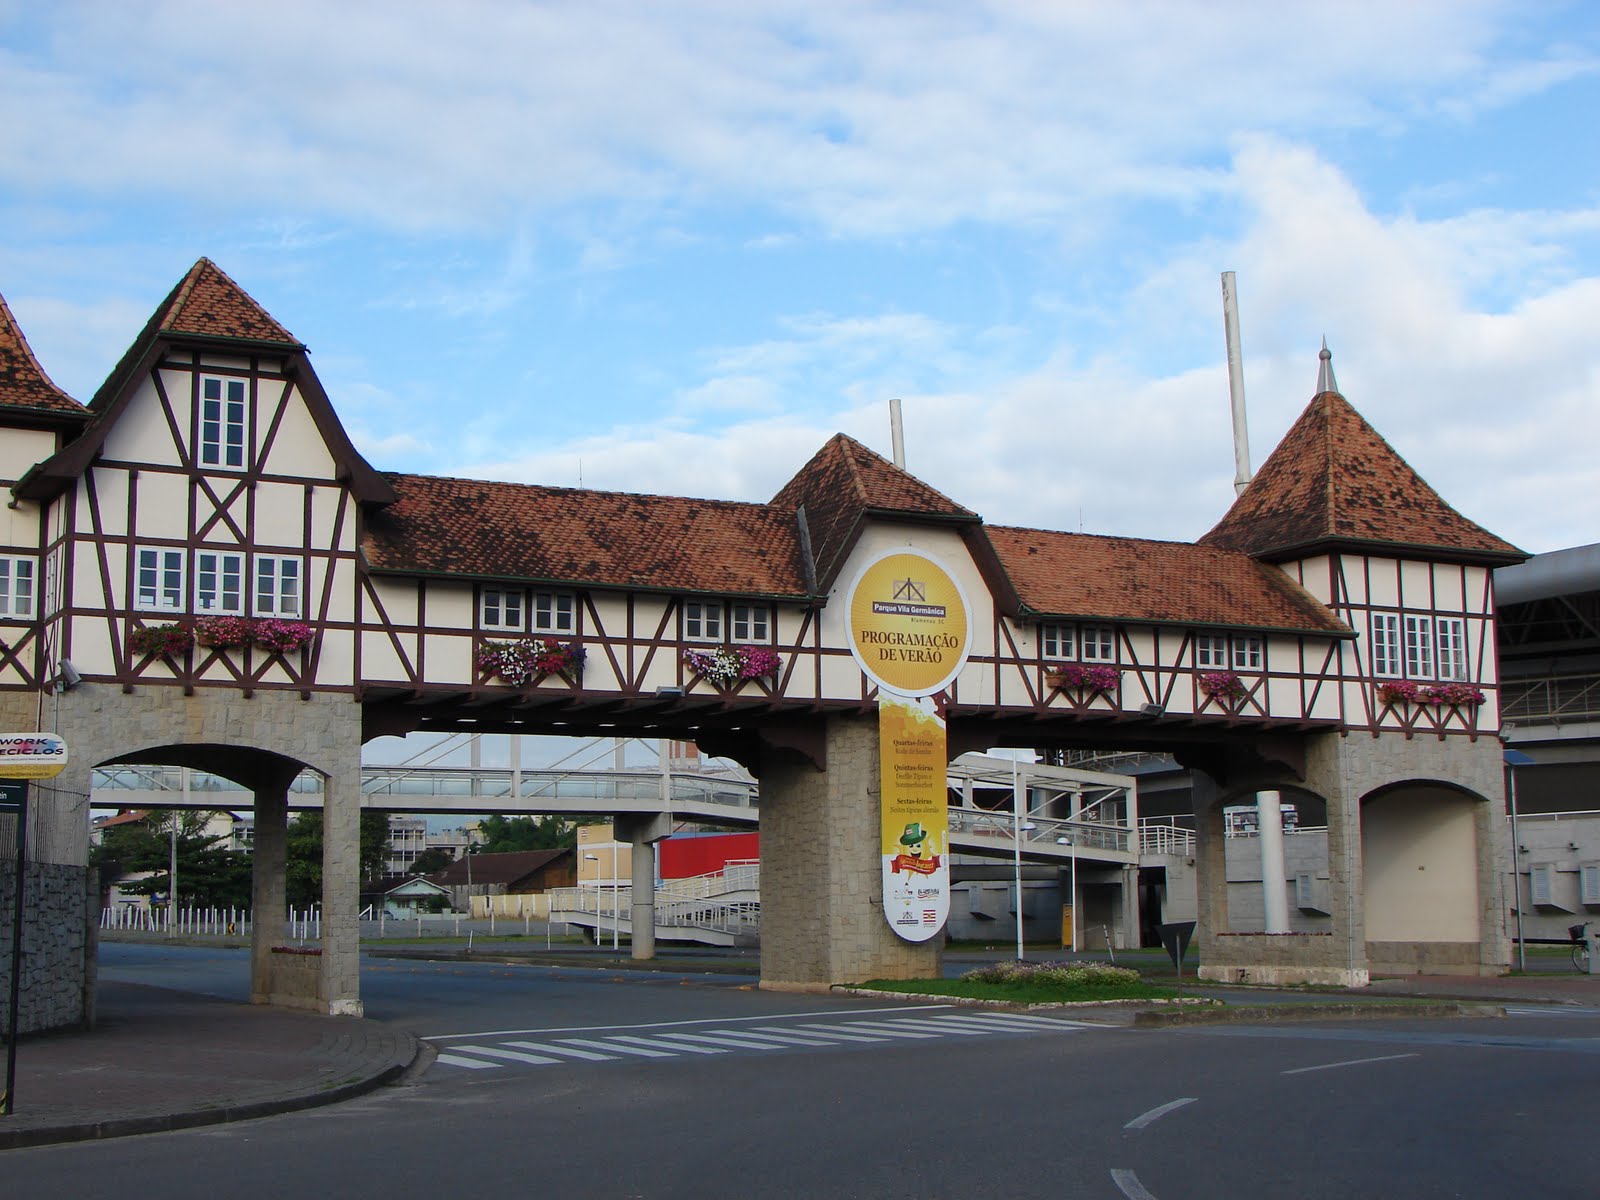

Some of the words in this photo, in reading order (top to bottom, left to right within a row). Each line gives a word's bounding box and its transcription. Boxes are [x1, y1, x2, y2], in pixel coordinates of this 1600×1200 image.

[874, 603, 897, 612] Parque
[898, 605, 910, 613] Vila
[911, 606, 945, 615] Germânica
[861, 630, 958, 650] PROGRAMAÇÃO
[880, 648, 897, 661] DE
[899, 648, 942, 663] VERÃO
